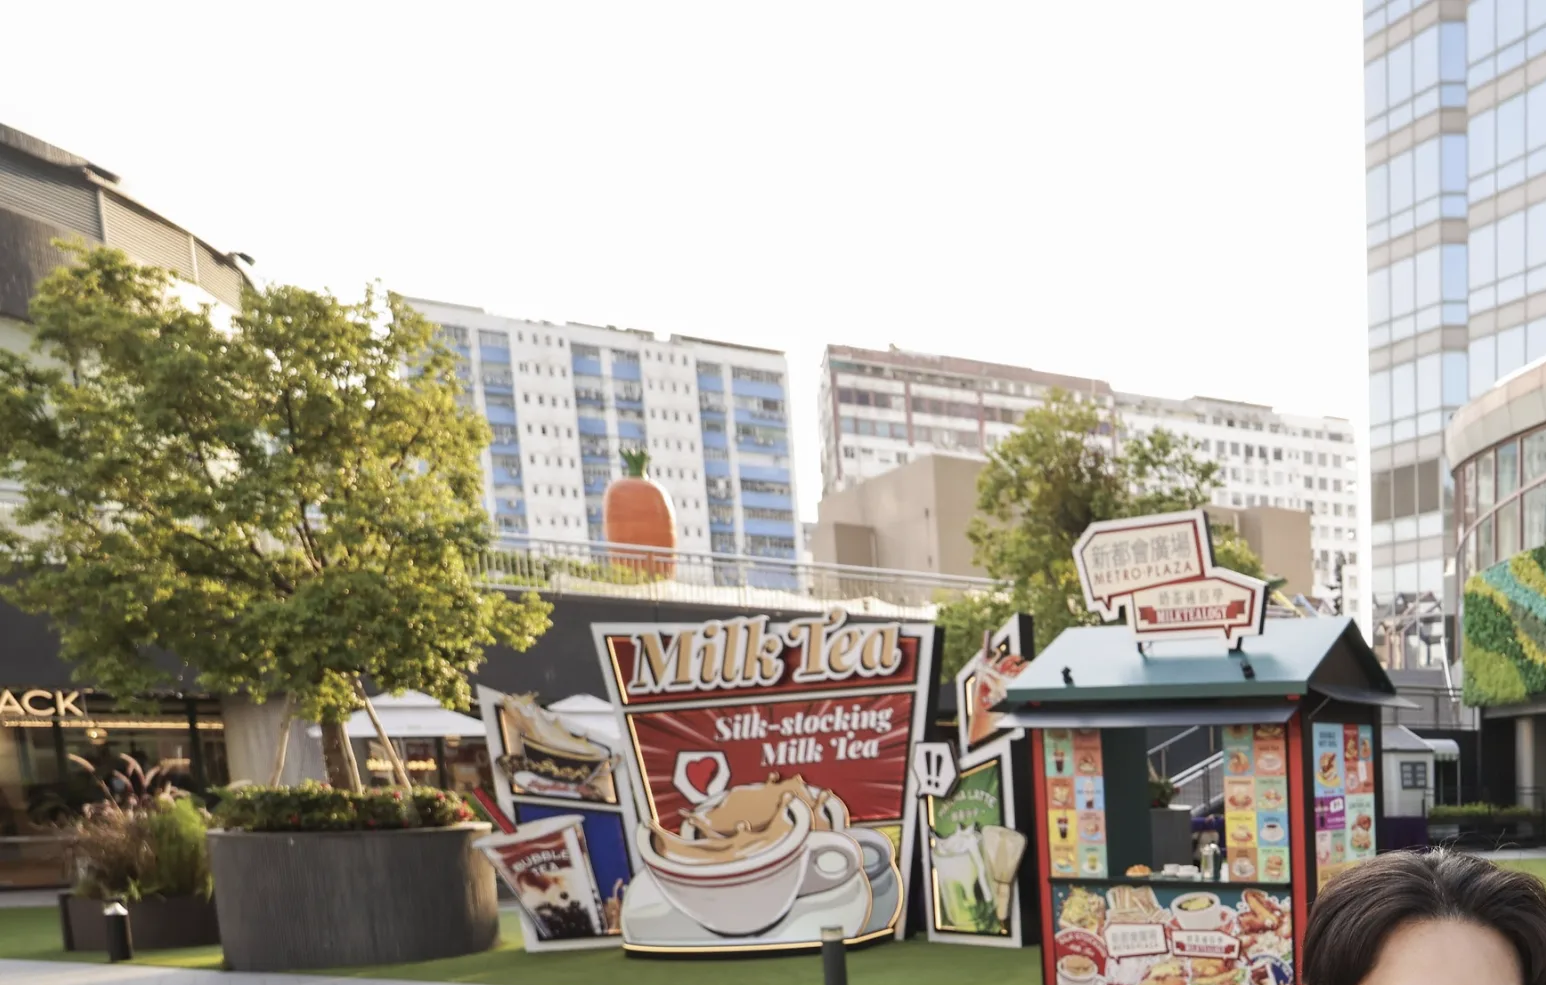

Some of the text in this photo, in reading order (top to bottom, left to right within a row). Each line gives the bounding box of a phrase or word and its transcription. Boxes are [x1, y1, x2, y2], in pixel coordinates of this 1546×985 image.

[630, 609, 901, 691] Milk Tea
[715, 704, 894, 741] Silk-stocking
[761, 732, 881, 767] Milk Tea
[511, 849, 571, 873] BUBBLE
[531, 863, 560, 877] TEA
